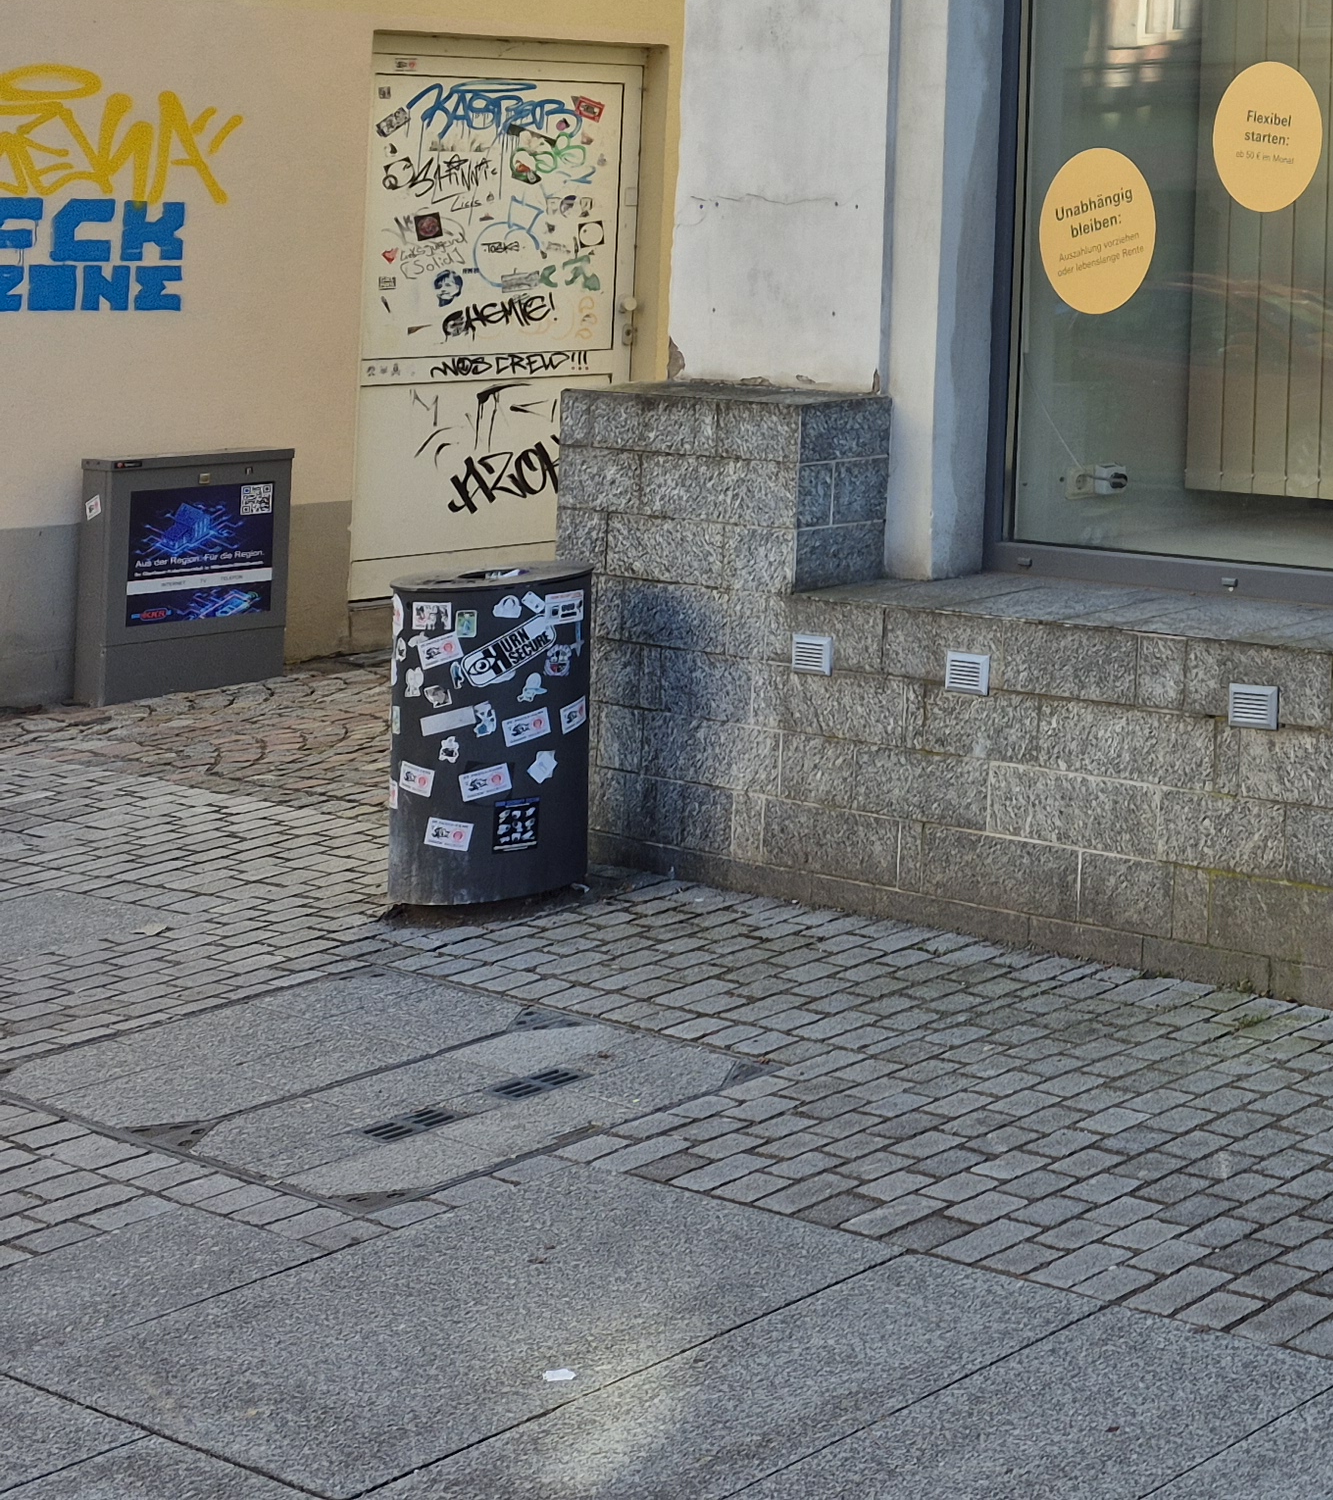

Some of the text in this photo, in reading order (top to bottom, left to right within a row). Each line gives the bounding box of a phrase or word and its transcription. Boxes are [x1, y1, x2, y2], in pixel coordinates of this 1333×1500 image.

[1246, 110, 1292, 127] Flexibel
[1244, 131, 1290, 146] starten:
[1246, 151, 1254, 159] 50
[1055, 187, 1133, 222] Unabhängig
[1071, 214, 1122, 238] bleiben:
[1058, 232, 1139, 262] Auszahlung vorziehen
[1057, 245, 1144, 277] oder lebenslange Rente
[135, 560, 151, 568] Aus
[153, 559, 167, 567] der
[220, 552, 232, 560] die
[234, 550, 265, 559] Region.
[508, 630, 552, 665] SECURE
